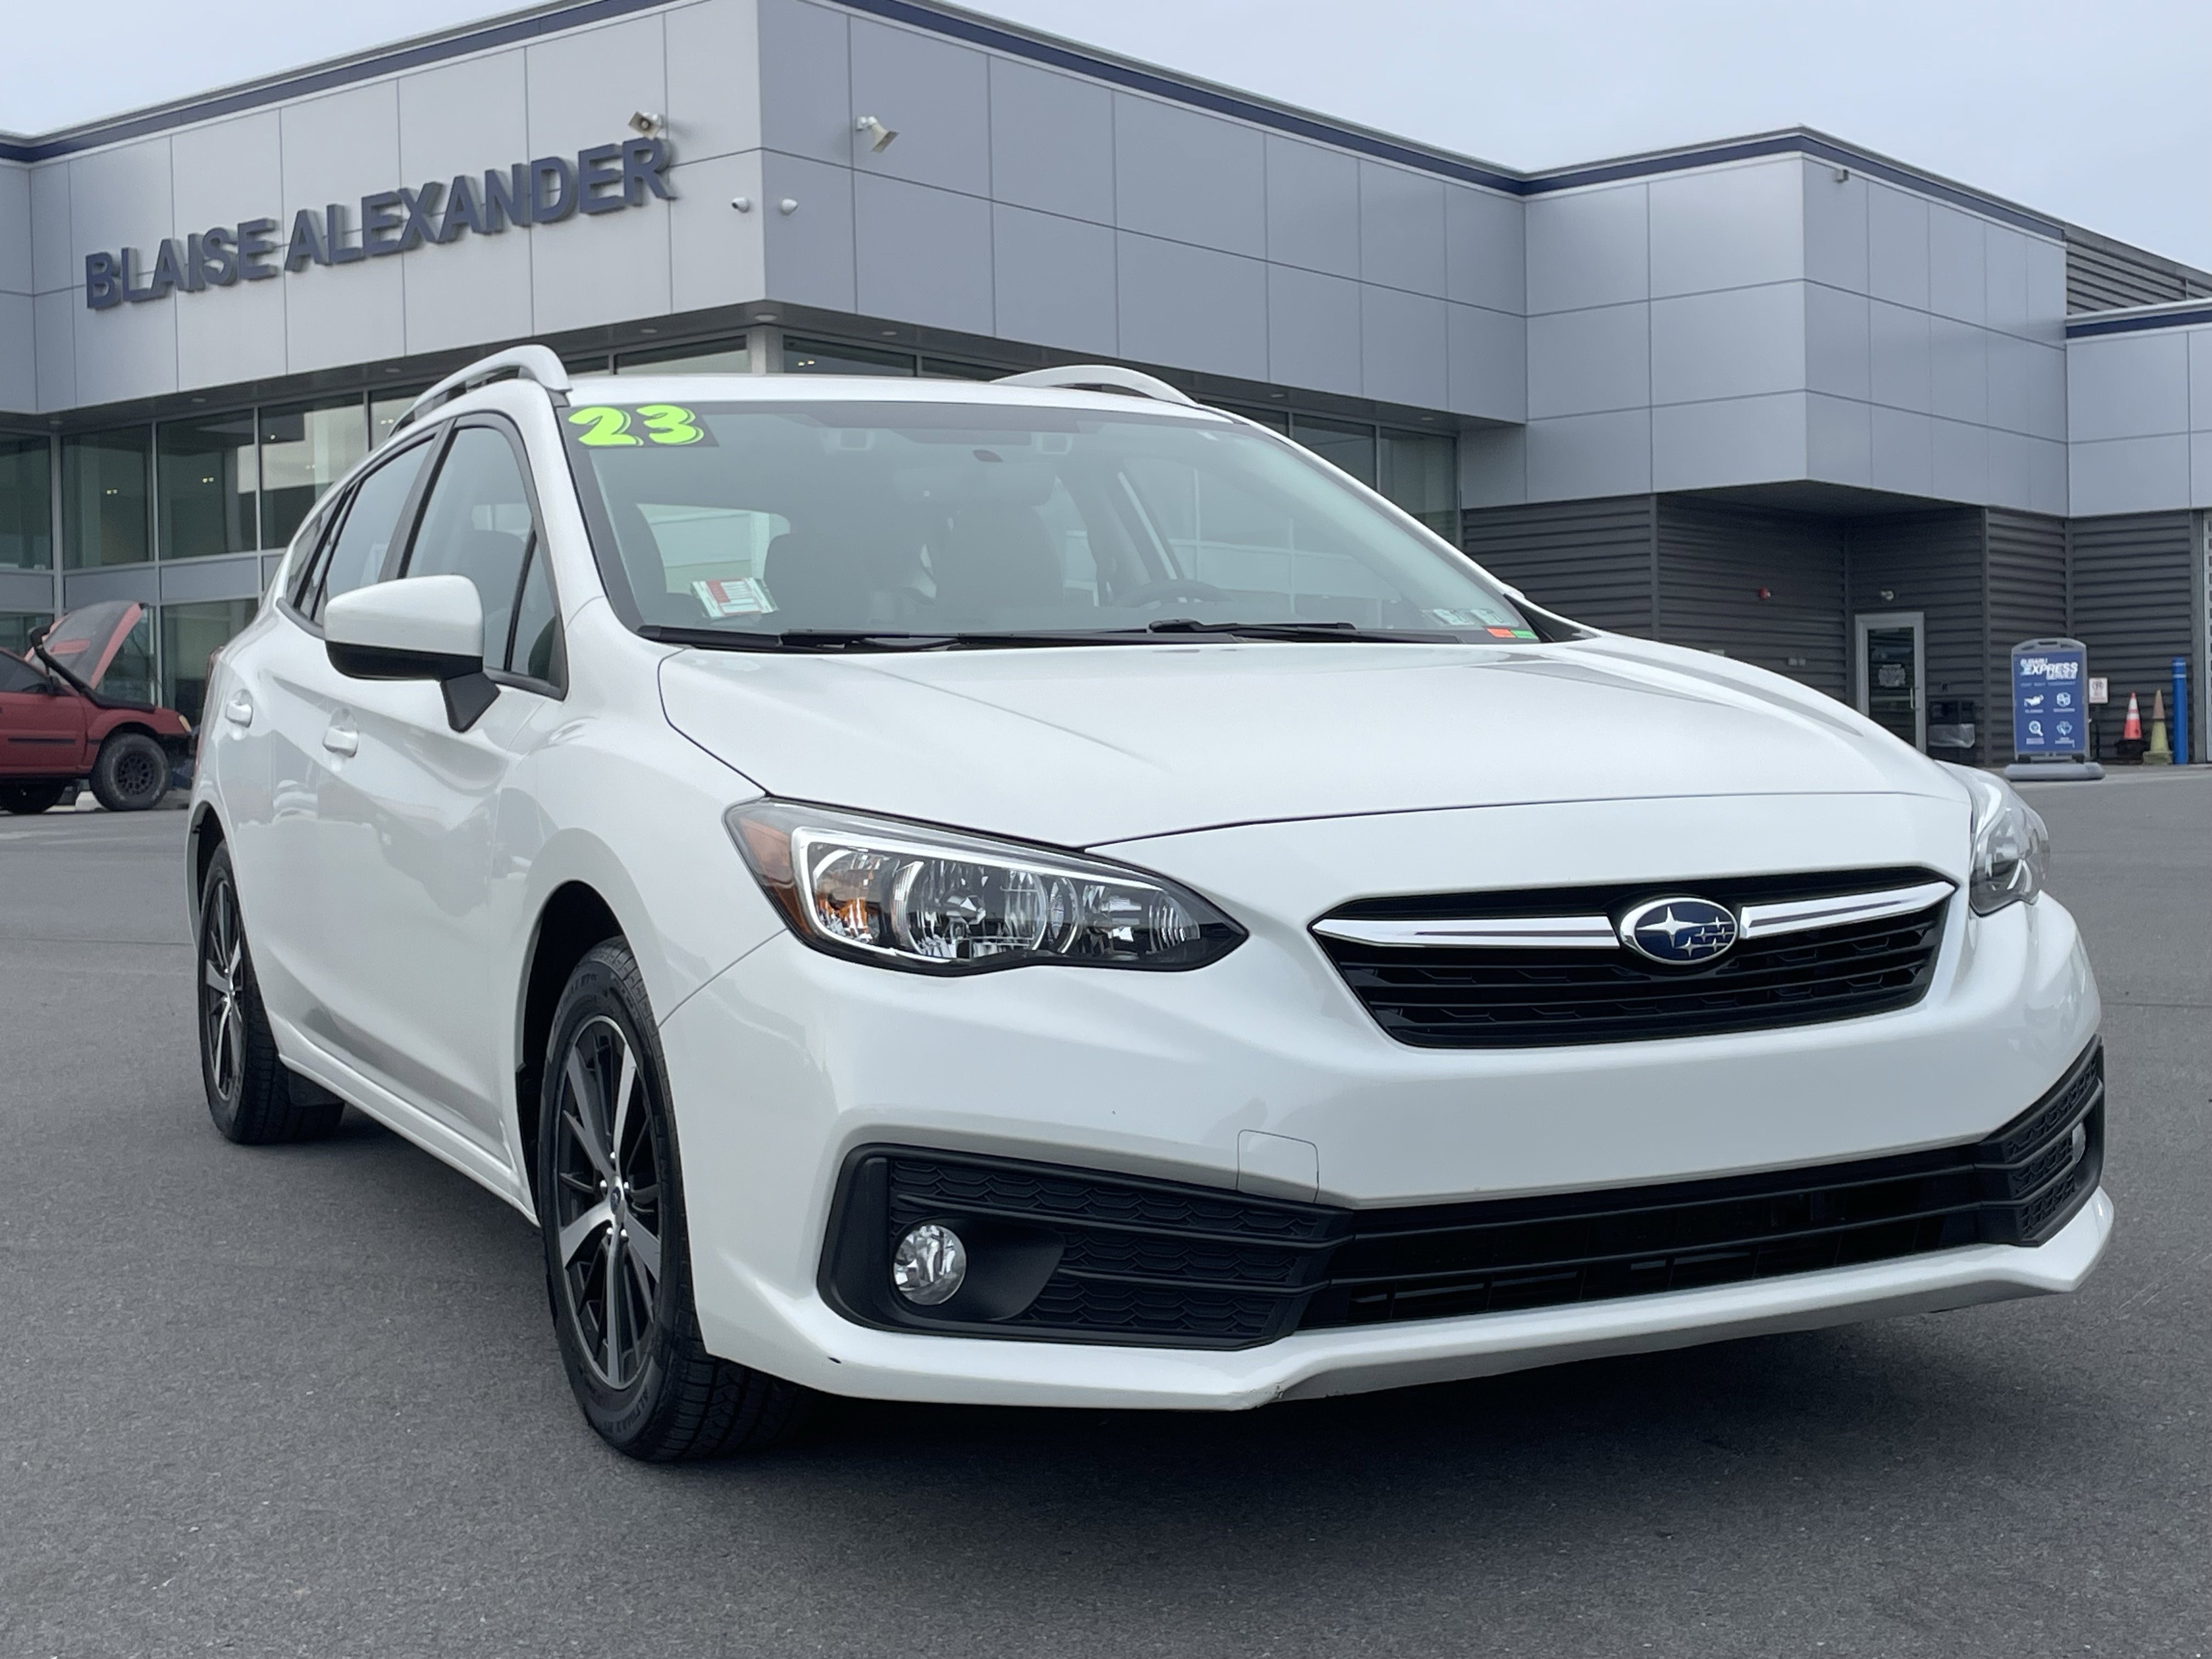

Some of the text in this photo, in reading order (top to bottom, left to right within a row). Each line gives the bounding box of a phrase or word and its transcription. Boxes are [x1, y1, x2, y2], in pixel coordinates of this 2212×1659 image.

[86, 137, 678, 309] BLAISE ALEXANDER
[568, 404, 704, 446] 23
[2023, 662, 2078, 675] EXPRESS
